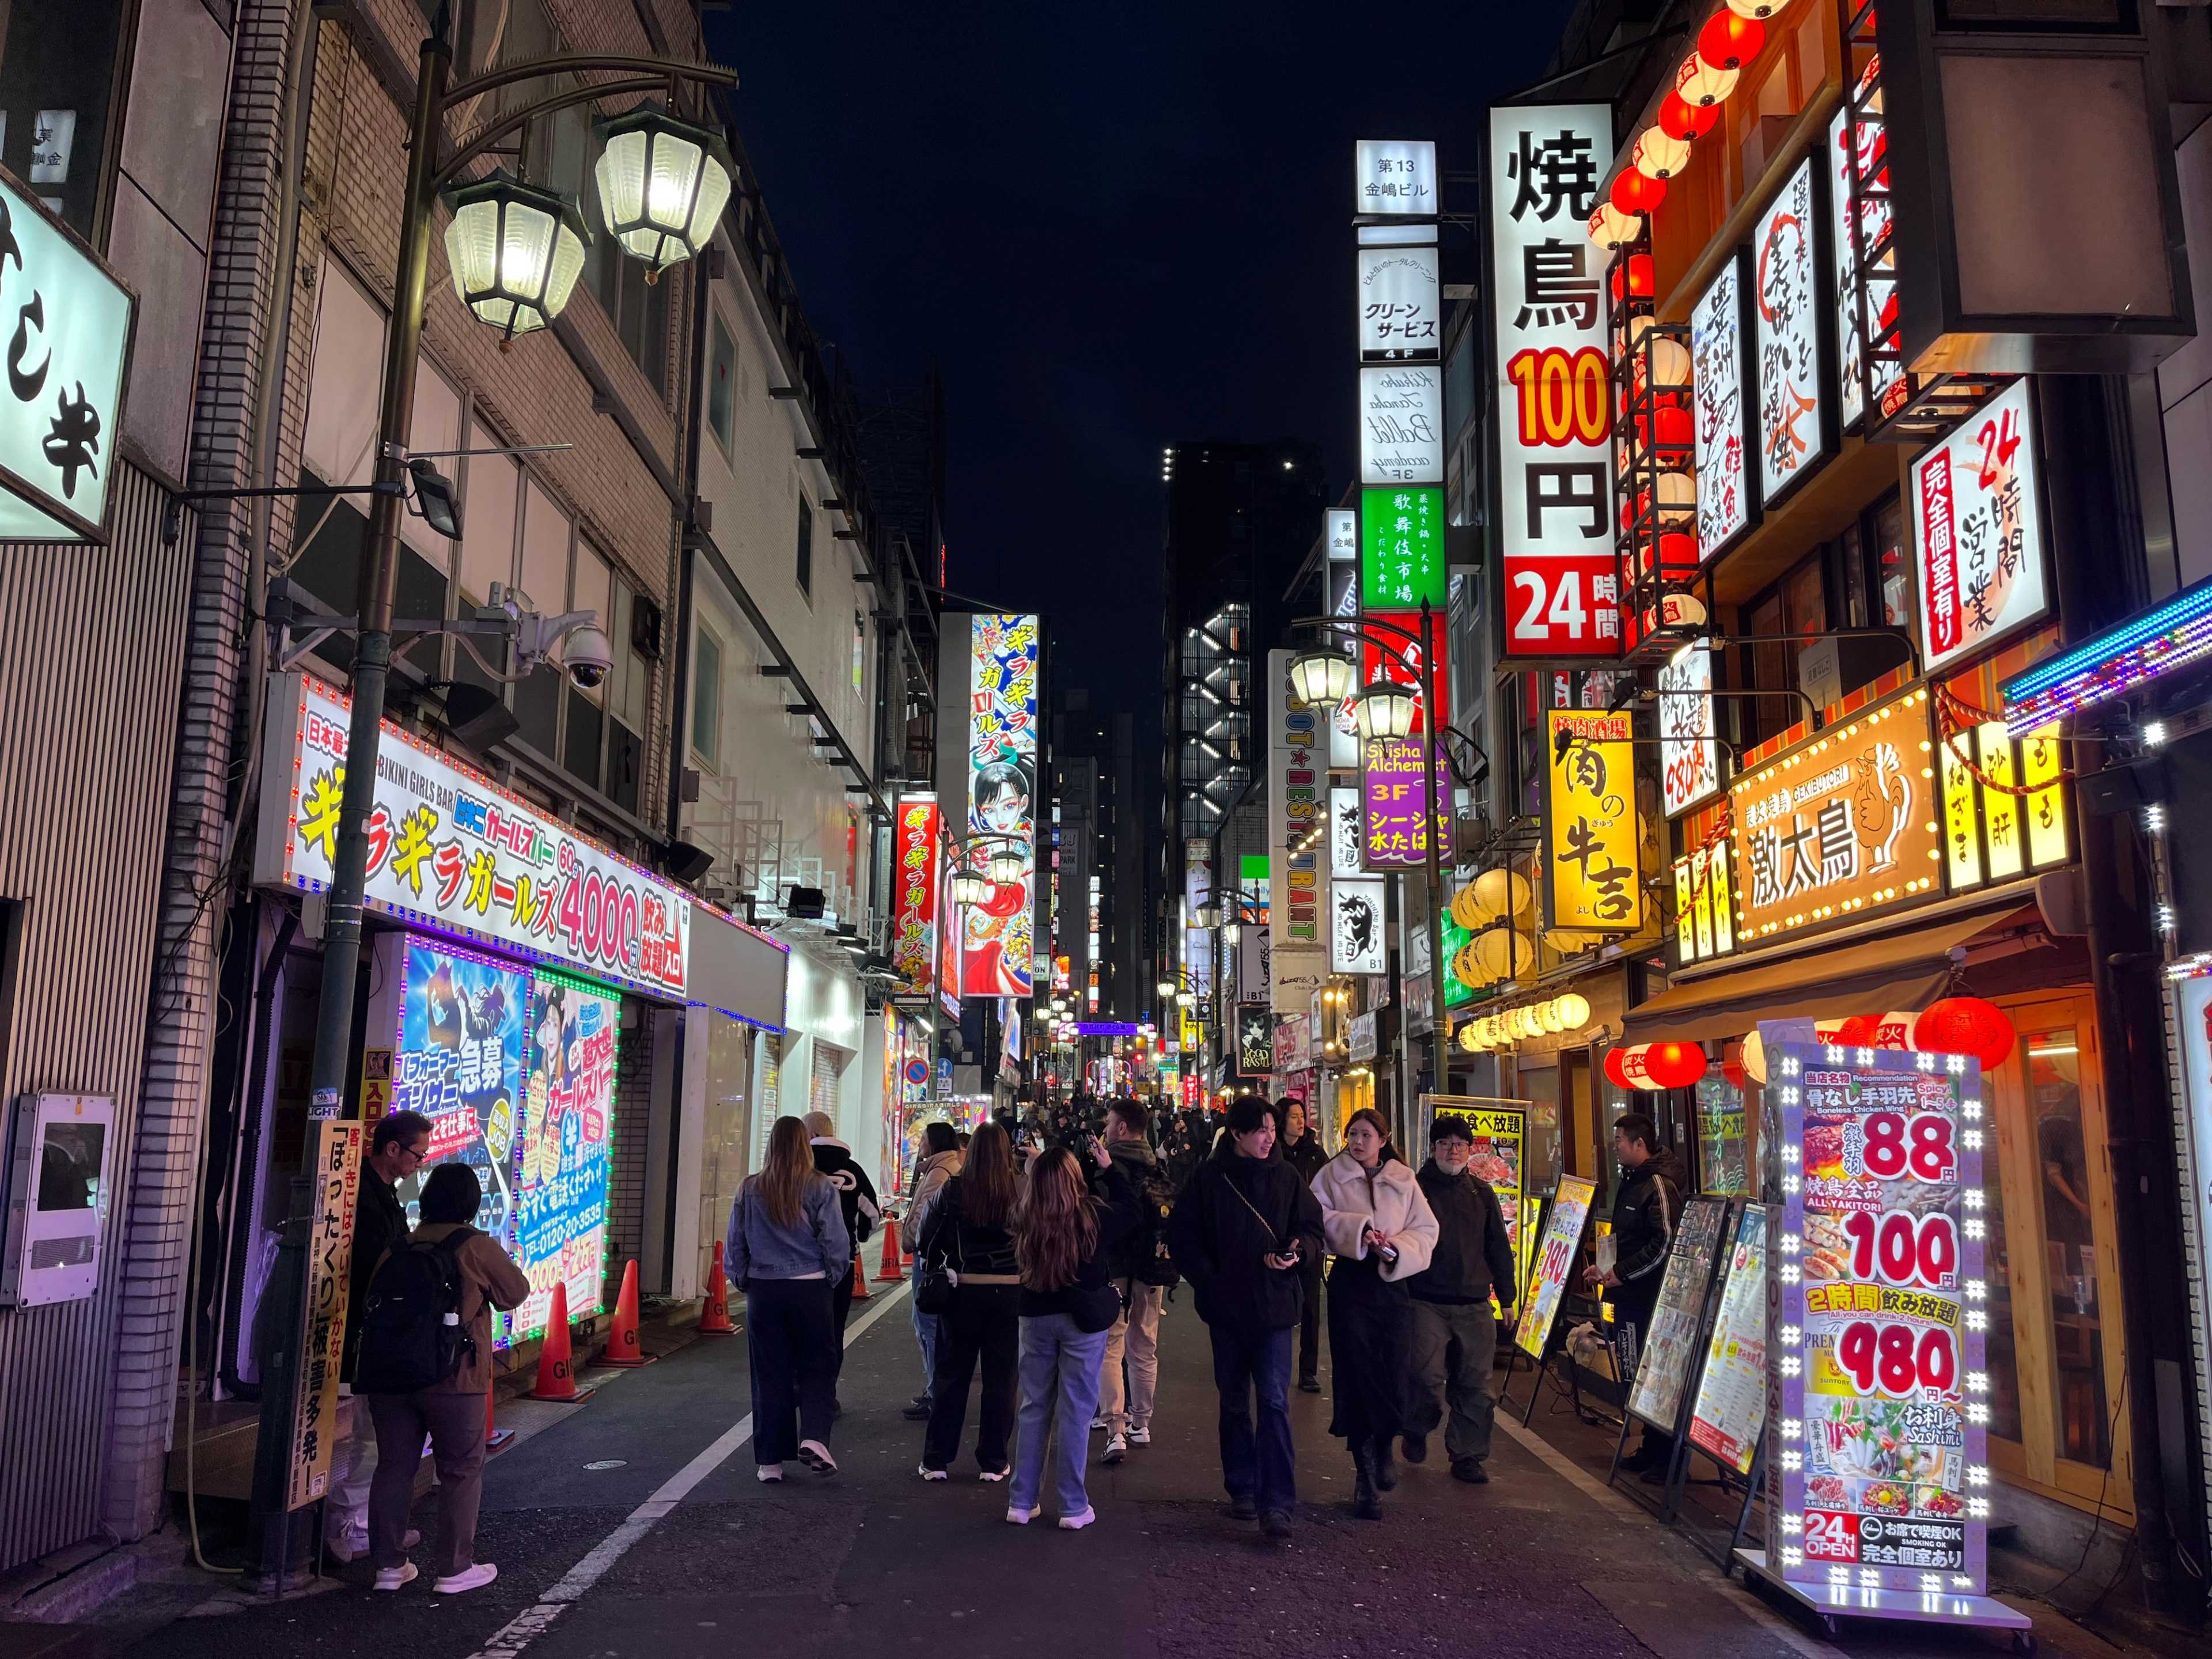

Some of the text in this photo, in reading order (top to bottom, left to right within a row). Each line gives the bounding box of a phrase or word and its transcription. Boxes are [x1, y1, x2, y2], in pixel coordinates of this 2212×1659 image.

[1365, 182, 1429, 197] 金嶋ビル
[1506, 129, 1601, 332] 焼鳥
[1365, 303, 1421, 319] クリーン
[1377, 321, 1437, 339] サービス
[1509, 347, 1611, 445] 100
[1976, 407, 2021, 491] 24
[1524, 461, 1610, 540] 円
[1342, 522, 1353, 533] 第
[1392, 493, 1414, 604] 歌舞伎市場
[1925, 461, 1954, 647] 完全個室有り
[1513, 570, 1588, 639] 24
[1593, 574, 1619, 640] 時間
[1004, 625, 1034, 733] ギラギラ
[976, 666, 1003, 757] ガールズ
[308, 717, 350, 756] 日本最
[1367, 758, 1447, 773] Alchemst
[377, 756, 453, 812] BIKINI GIRLS BAR
[1372, 784, 1410, 801] 3F
[1792, 766, 1849, 802] GEKIBUTORI
[1591, 819, 1613, 828] ぎゅう
[1747, 798, 1860, 908] 激太鳥
[904, 805, 931, 958] ギラギラガールズ
[1244, 885, 1269, 896] Faily
[1575, 905, 1590, 915] よし
[665, 950, 680, 975] 入口
[1369, 959, 1382, 969] B1
[460, 1036, 503, 1093] 急募
[1805, 1071, 1851, 1085] 当店名物
[1806, 1085, 1917, 1108] 骨なし手羽先
[1817, 1106, 1851, 1114] Boneless
[1853, 1105, 1884, 1113] Chicken
[490, 1130, 506, 1152] JOB
[1843, 1123, 1862, 1175] 激手羽
[1805, 1176, 1884, 1198] 焼鳥全品
[1807, 1198, 1882, 1212] ALL YAKITORI
[1904, 1406, 1963, 1431] お刺身
[1907, 1426, 1962, 1446] Sashimi
[1946, 1455, 1960, 1490] 馬刺し
[1885, 1521, 1962, 1541] お席で喫煙OK
[1901, 1539, 1947, 1548] SMOKING OK
[1805, 1541, 1855, 1558] OPEN
[1862, 1543, 1963, 1569] 完全個室あり
